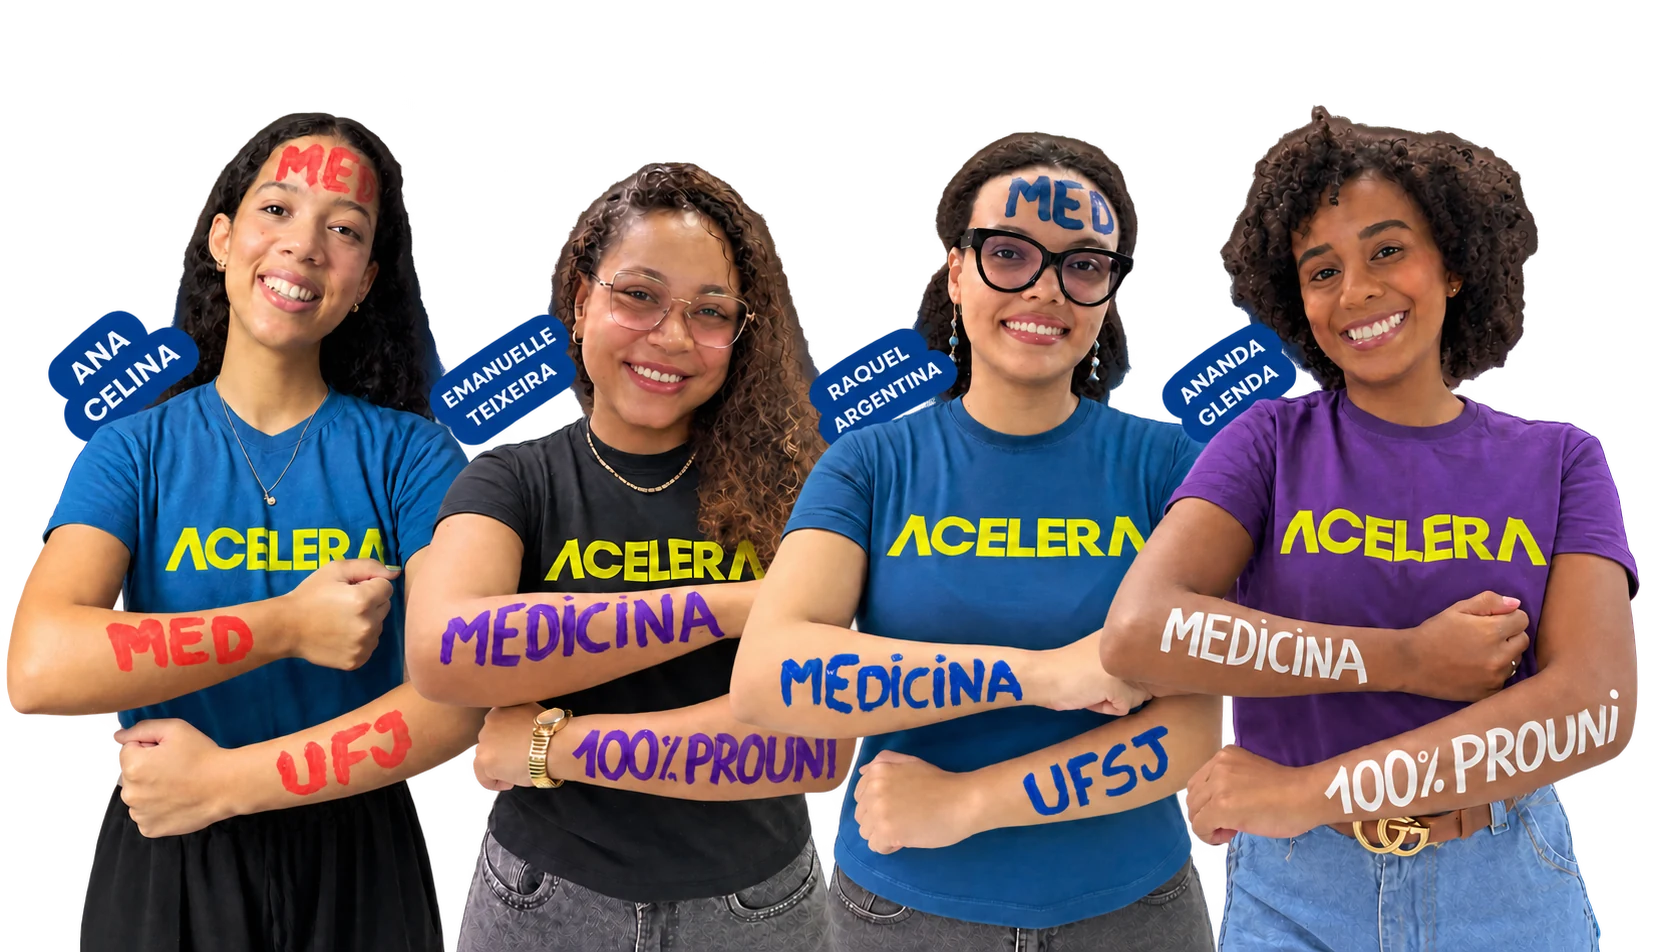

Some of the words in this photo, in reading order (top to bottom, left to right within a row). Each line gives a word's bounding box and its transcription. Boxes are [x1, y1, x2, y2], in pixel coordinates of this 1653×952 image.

[276, 144, 376, 204] MED
[1005, 176, 1114, 235] MED
[165, 527, 385, 572] ACELERA
[544, 538, 766, 582] ACELERA
[886, 514, 1145, 558] ACELERA
[1279, 508, 1548, 567] ACELERA
[106, 615, 254, 672] MED
[276, 709, 413, 796] UFJ
[1023, 725, 1168, 815] UFSJ
